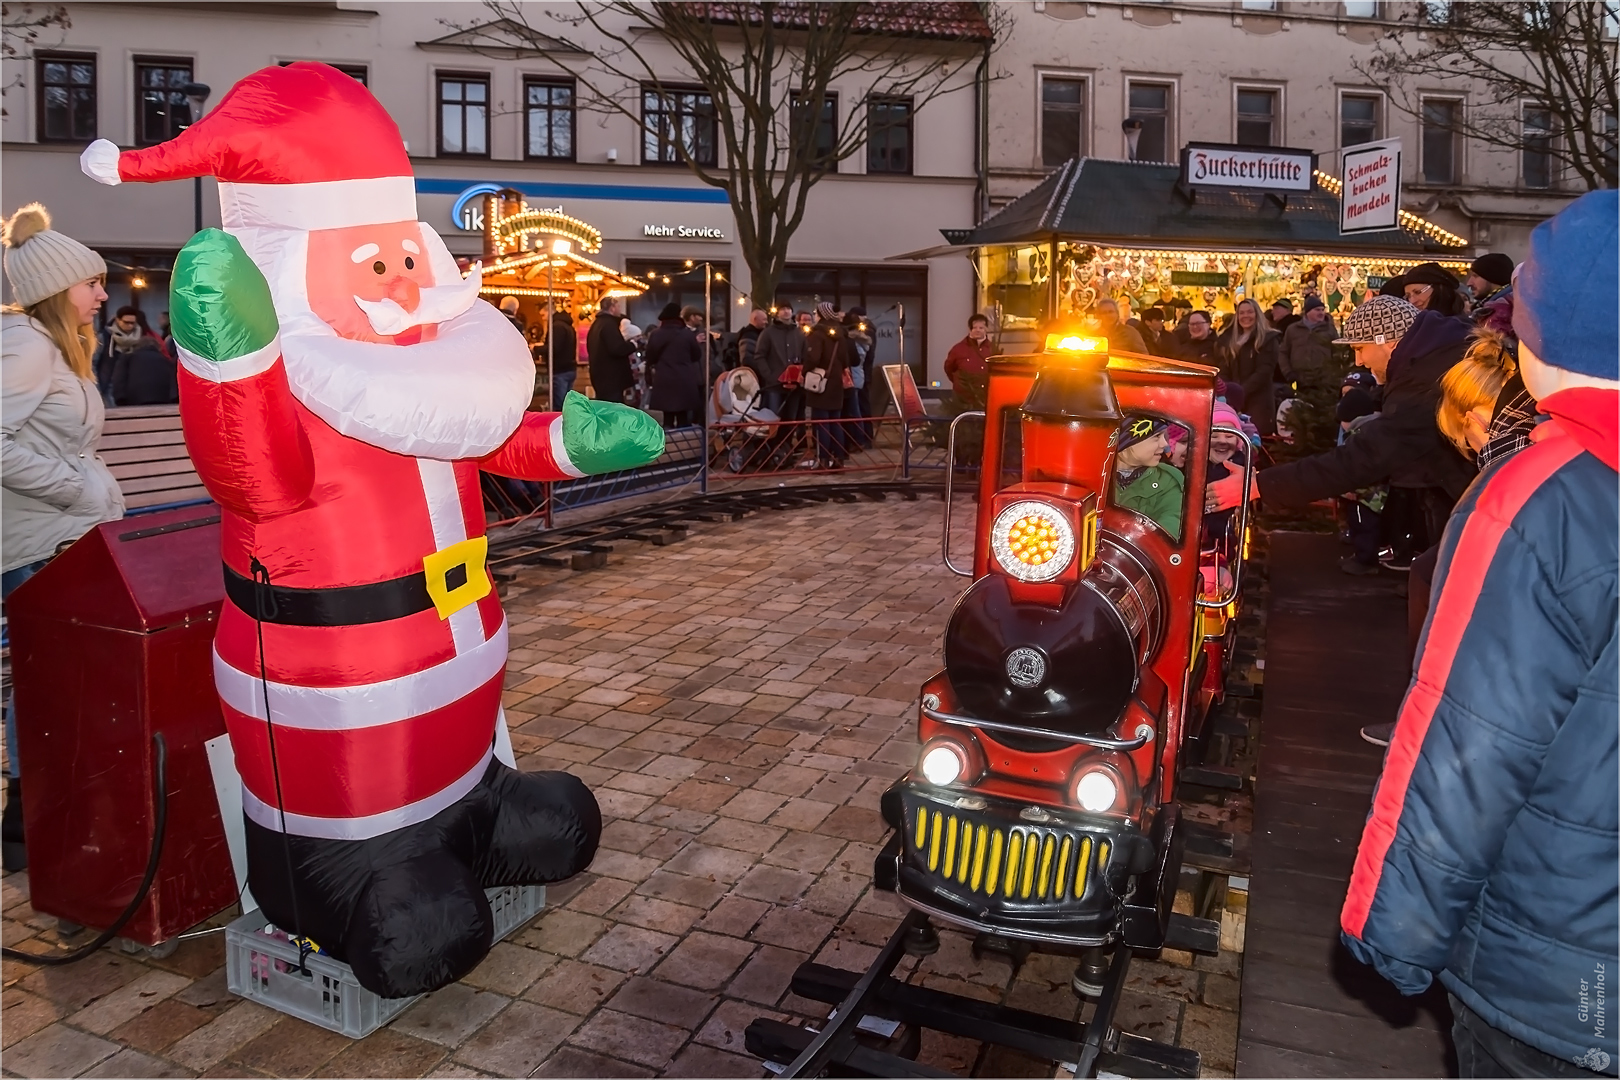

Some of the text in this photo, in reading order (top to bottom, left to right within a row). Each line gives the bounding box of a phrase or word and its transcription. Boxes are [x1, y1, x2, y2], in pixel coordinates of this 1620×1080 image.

[1194, 153, 1301, 183] Zuckerhütte
[1348, 155, 1393, 182] Schmalz-
[1352, 174, 1387, 197] kuchen
[1347, 192, 1391, 220] Mandeln
[644, 224, 725, 238] Mehr Service.
